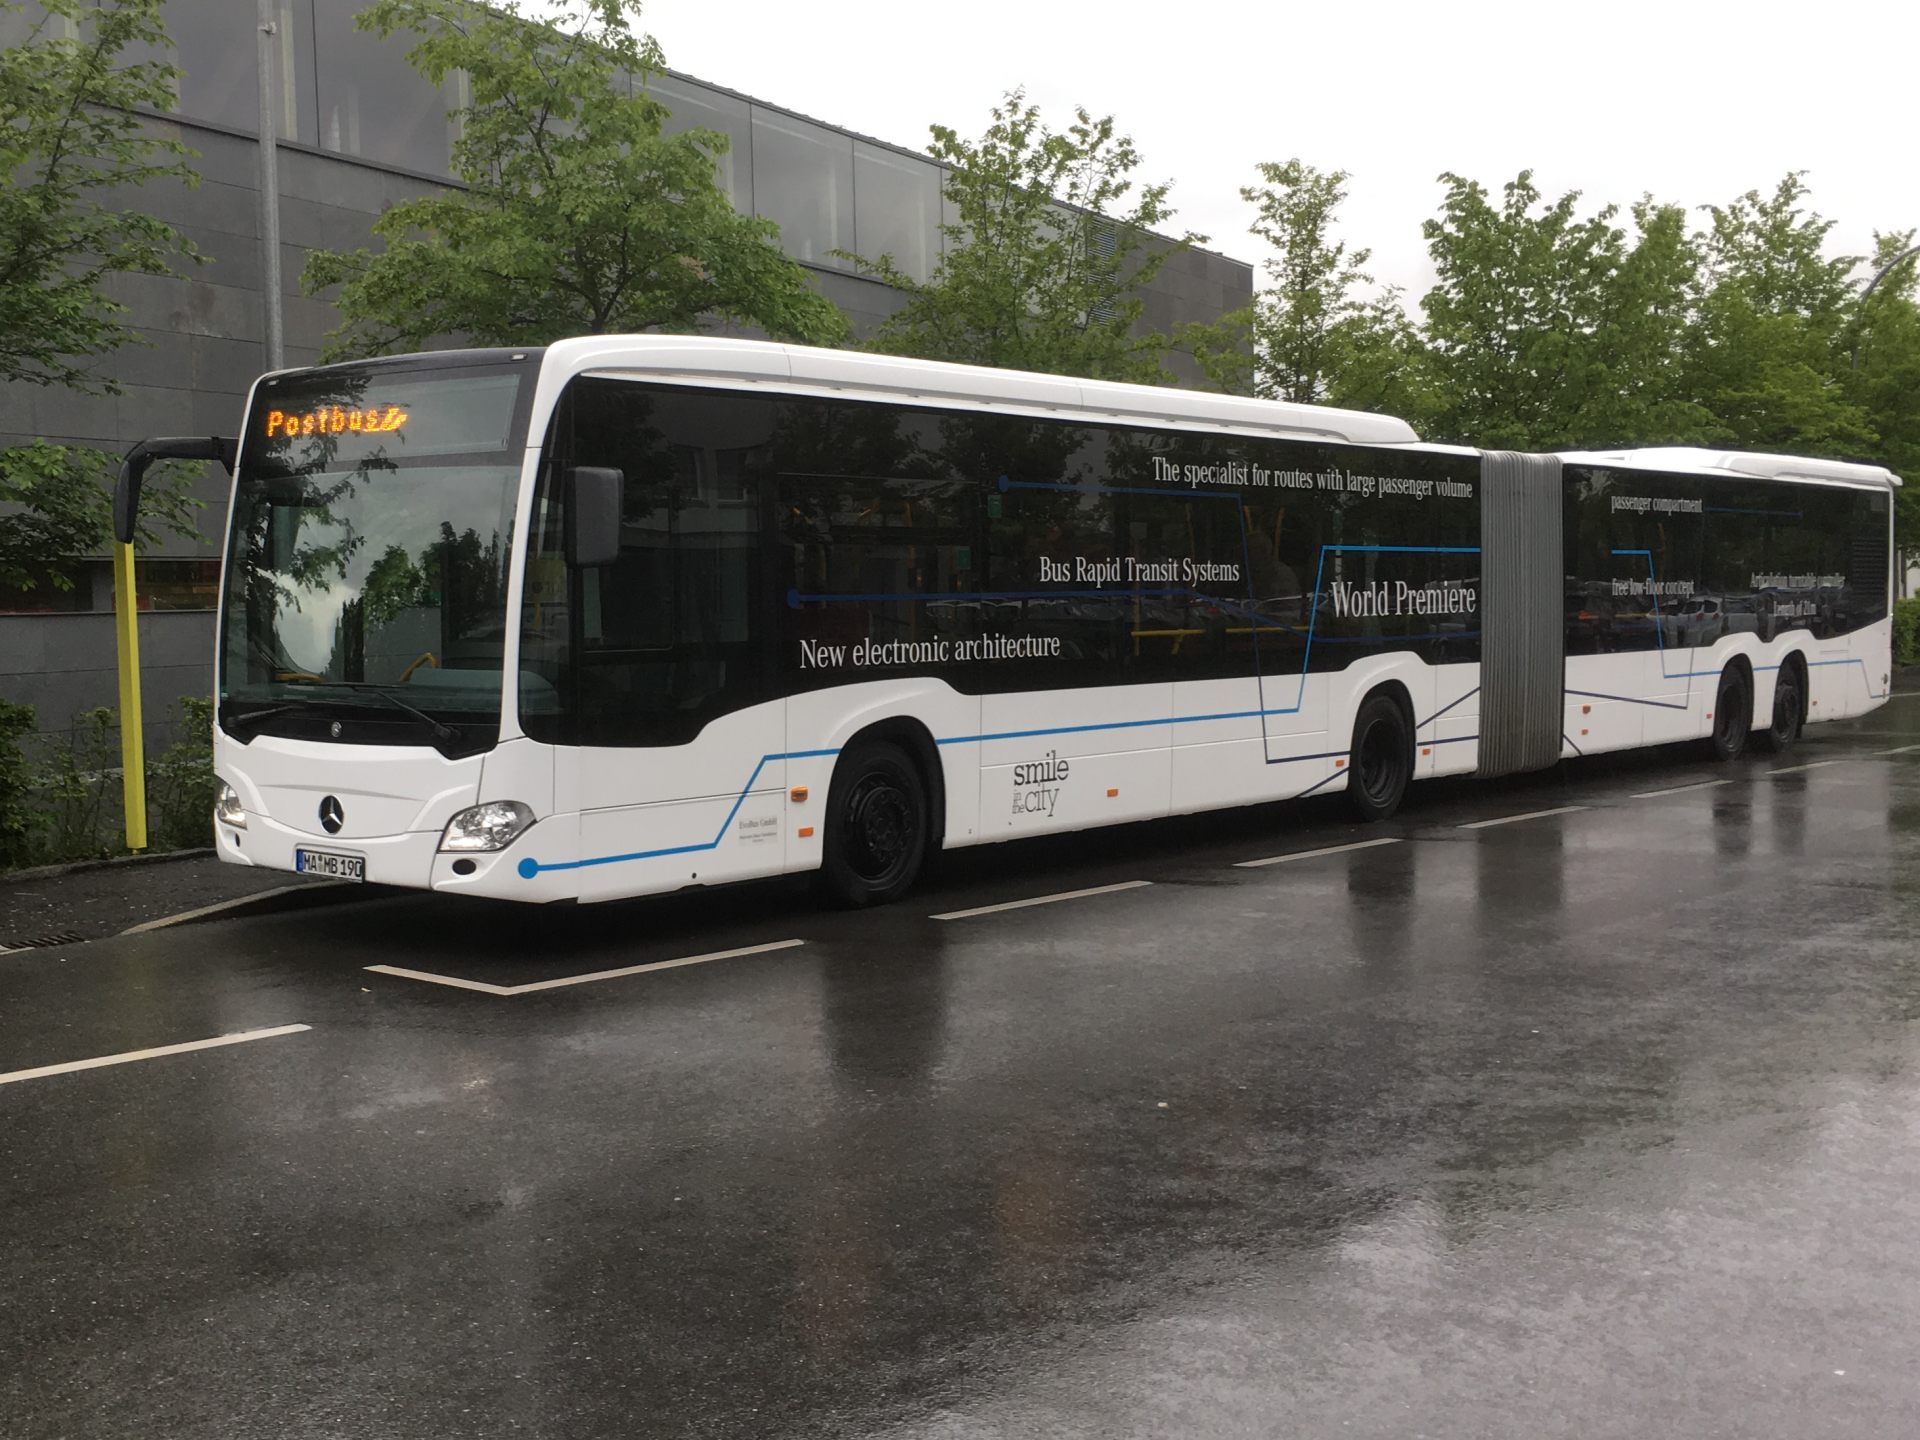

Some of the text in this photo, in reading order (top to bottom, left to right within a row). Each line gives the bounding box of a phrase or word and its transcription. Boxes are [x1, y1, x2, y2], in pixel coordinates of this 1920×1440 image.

[1152, 456, 1473, 500] The specialist for routes with large passenger volume
[1611, 495, 1703, 517] passenger compartment
[1039, 556, 1240, 589] Bus Rapid Transit Systems
[1612, 578, 1629, 596] free
[1665, 580, 1695, 599] concept
[1330, 580, 1476, 618] World Premiere
[799, 632, 1061, 669] New electronic architecture
[1014, 749, 1069, 786] smile
[1024, 782, 1060, 818] city
